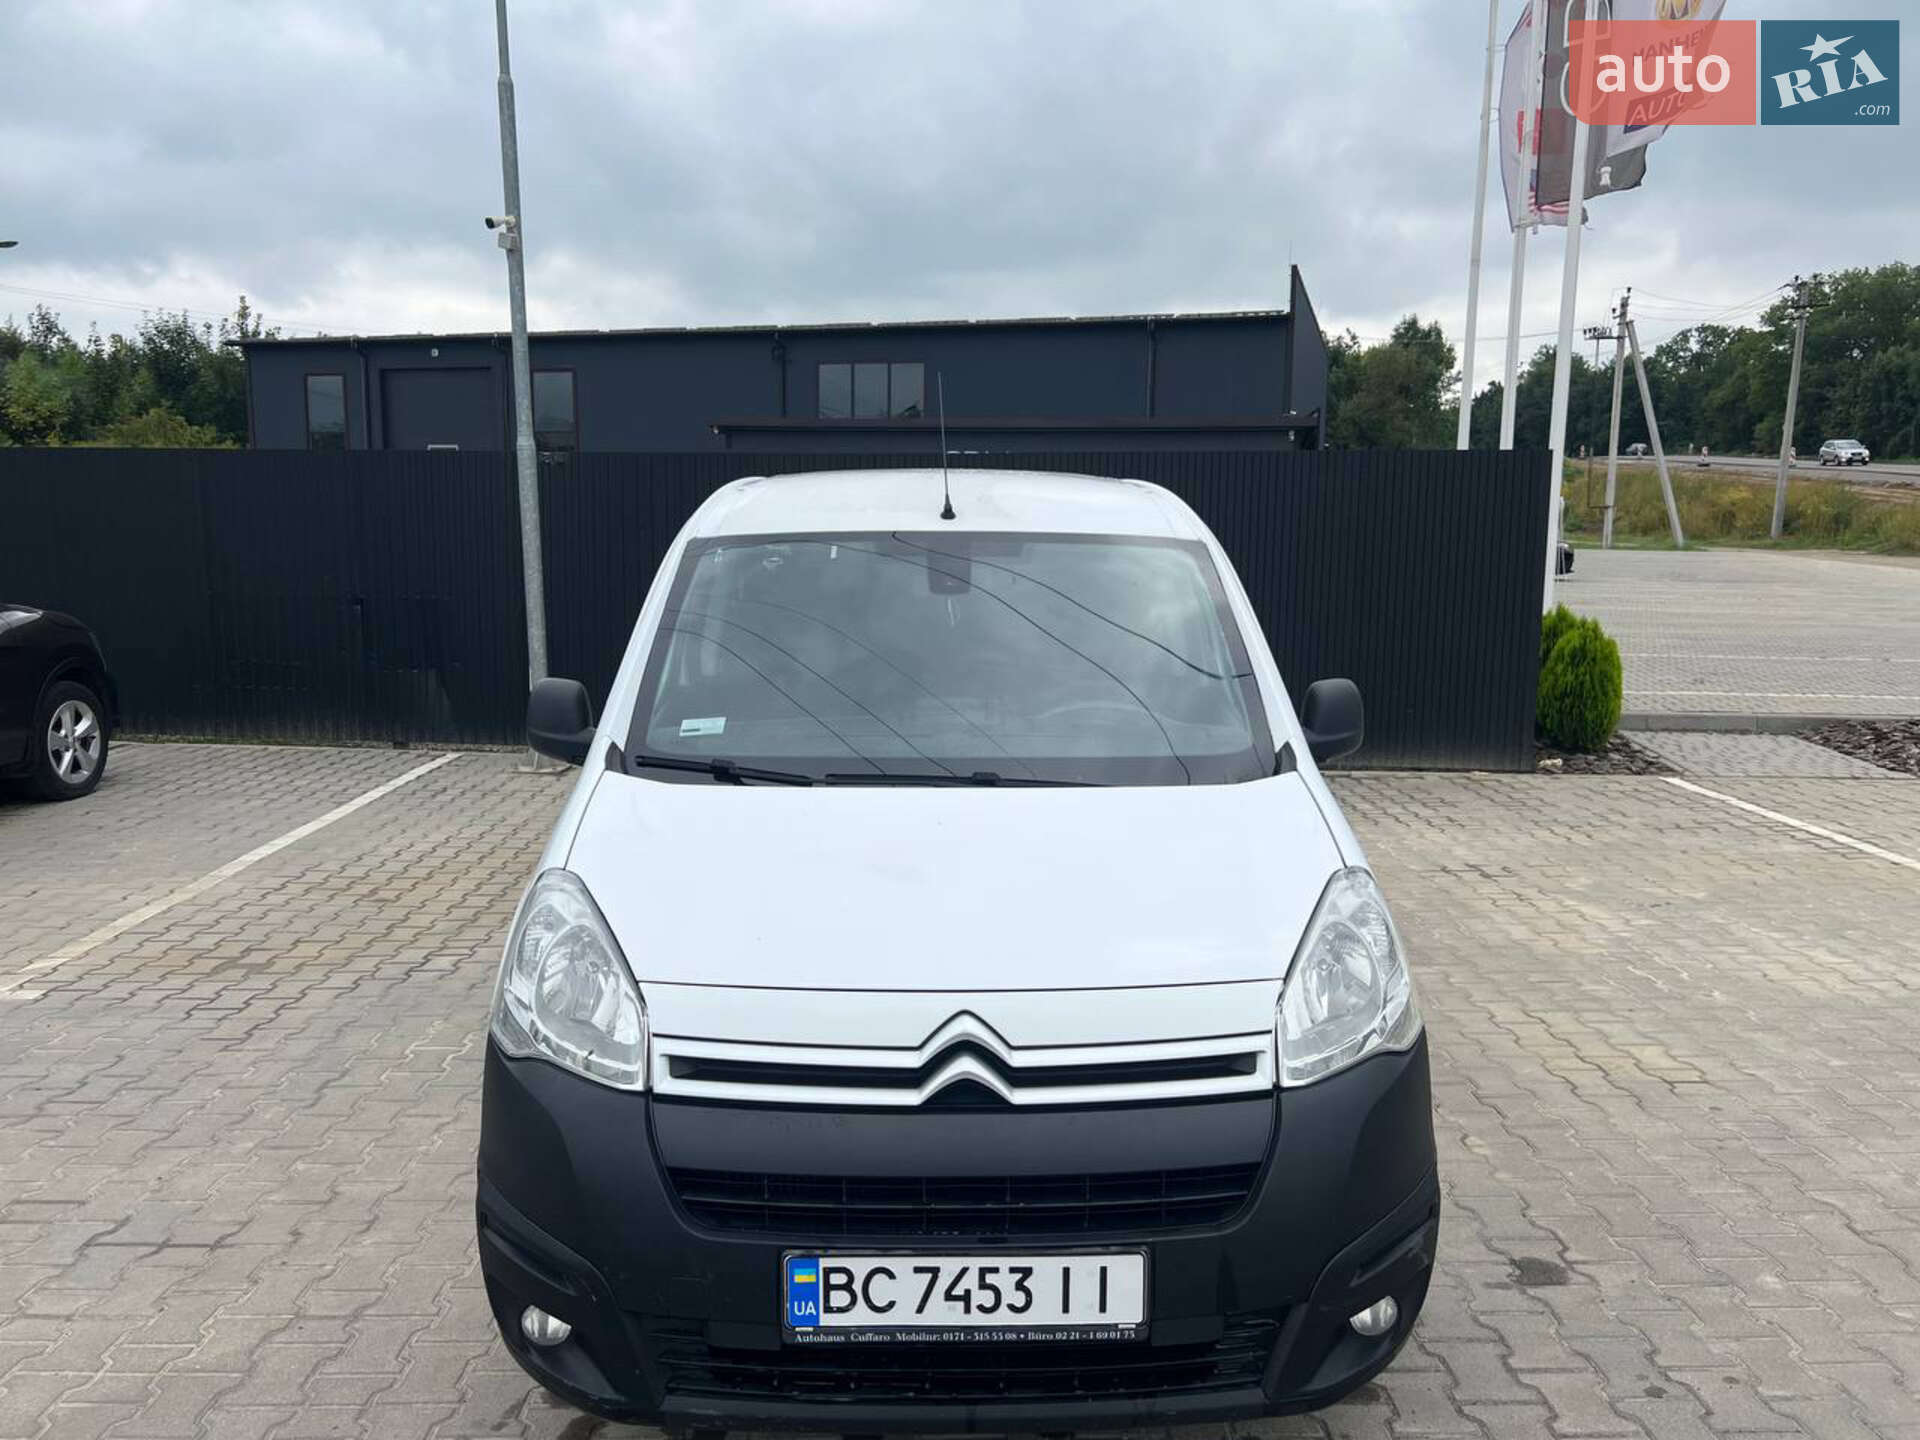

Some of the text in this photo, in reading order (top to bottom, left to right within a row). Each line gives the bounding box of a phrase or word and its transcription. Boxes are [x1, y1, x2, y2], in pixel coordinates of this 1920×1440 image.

[822, 1266, 897, 1314] BC
[912, 1266, 1033, 1314] 7453
[793, 1301, 817, 1316] UA
[794, 1332, 845, 1343] Autohaus
